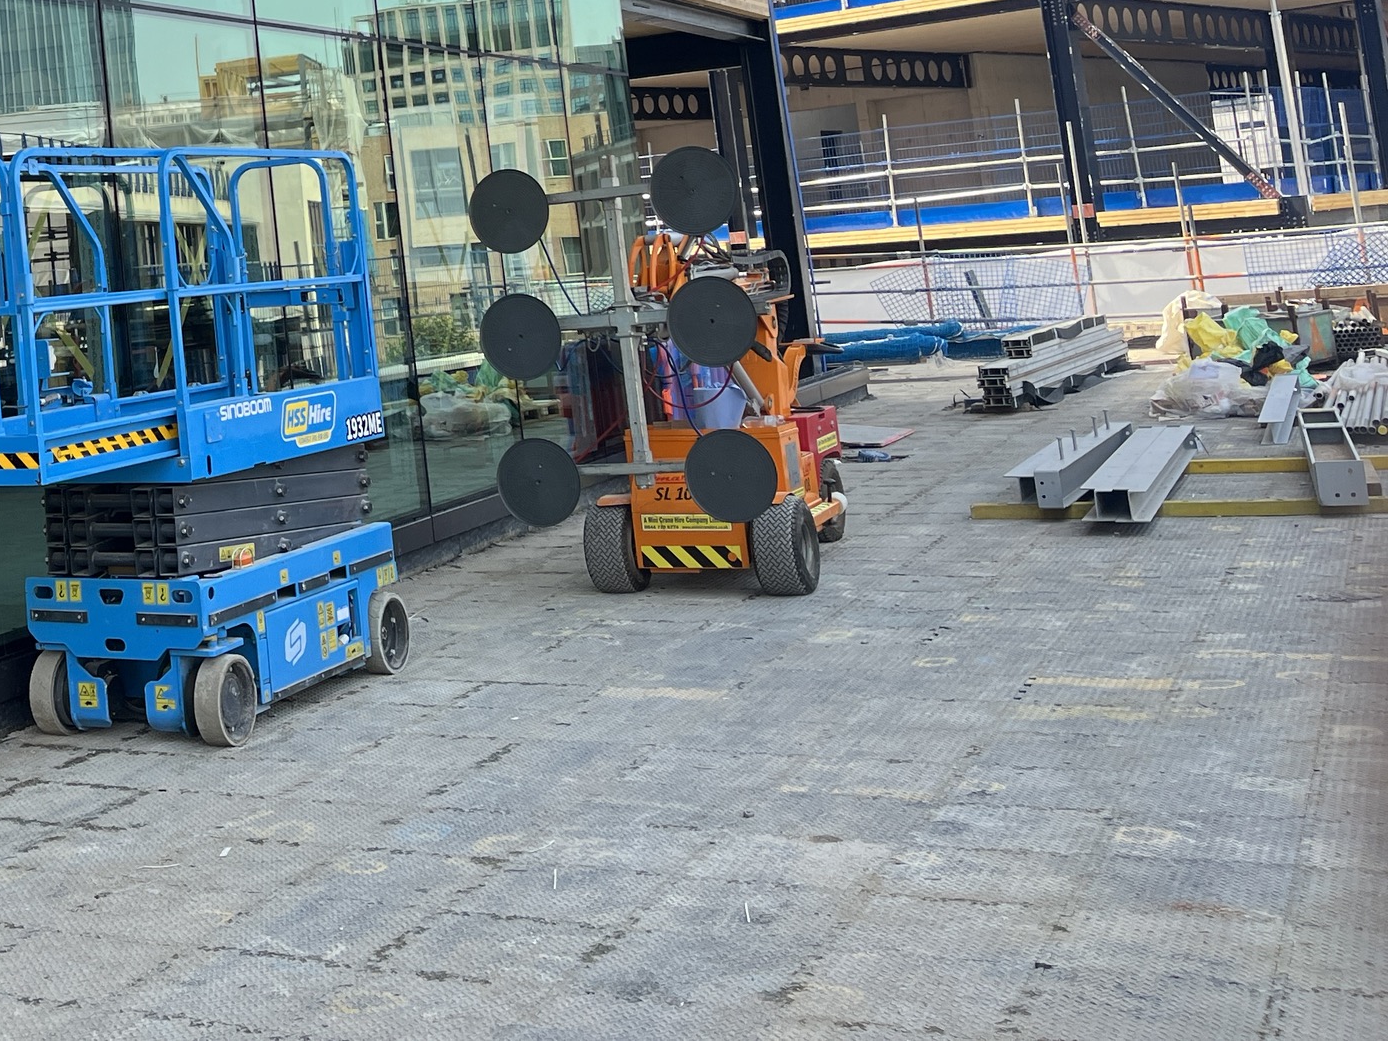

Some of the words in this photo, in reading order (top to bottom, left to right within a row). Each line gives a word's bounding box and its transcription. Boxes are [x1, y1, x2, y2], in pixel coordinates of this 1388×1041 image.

[220, 397, 272, 421] SINOBOOM
[286, 406, 306, 429] HSS
[309, 403, 332, 425] Hire
[346, 412, 383, 441] 1932ME
[654, 487, 671, 501] SL
